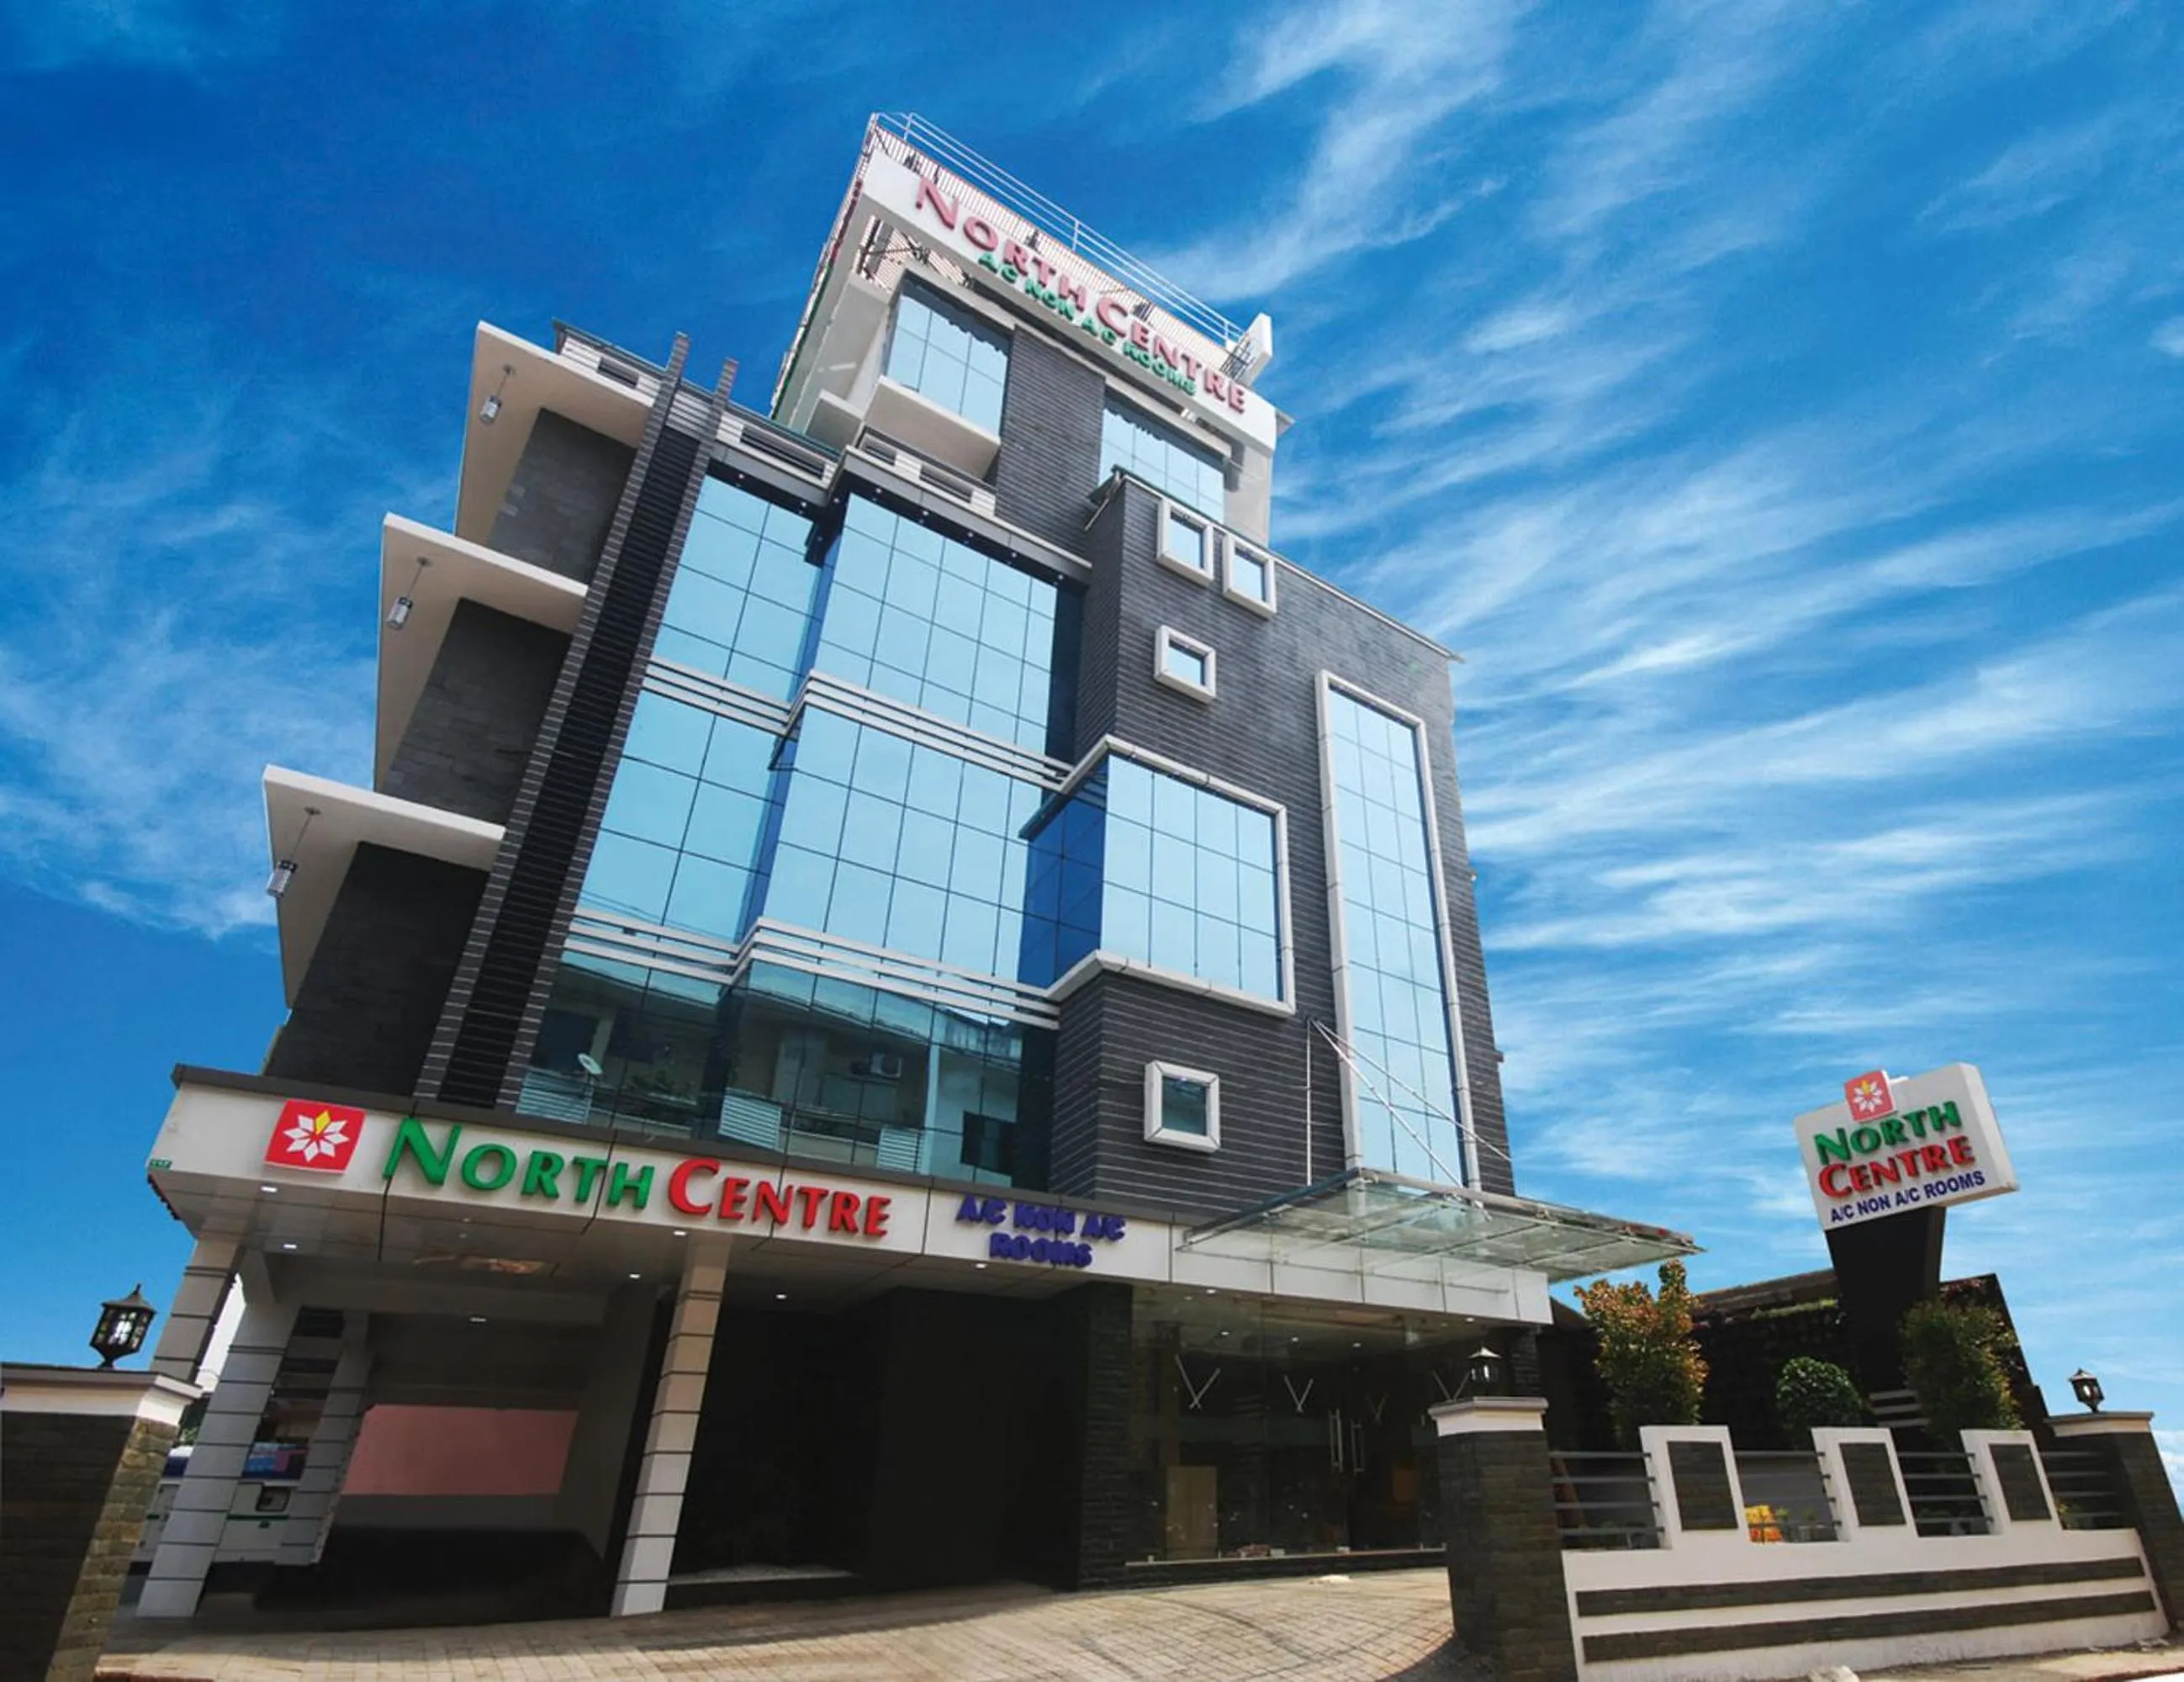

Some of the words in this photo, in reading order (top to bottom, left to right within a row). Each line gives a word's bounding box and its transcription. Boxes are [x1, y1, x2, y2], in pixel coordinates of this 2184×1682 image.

[915, 177, 1088, 313] NORTH
[1097, 296, 1246, 415] CENTRE
[1813, 1100, 1963, 1166] NORTH
[383, 1115, 656, 1210] NORTH
[667, 1156, 893, 1237] CENTRE
[1817, 1135, 1975, 1199] CENTRE
[1830, 1205, 1854, 1224] A/C
[1857, 1194, 1891, 1217] NON
[1895, 1187, 1921, 1208] A/C
[1923, 1170, 1986, 1198] ROOMS
[1013, 1200, 1076, 1235] NON
[988, 1232, 1092, 1268] ROOMS
